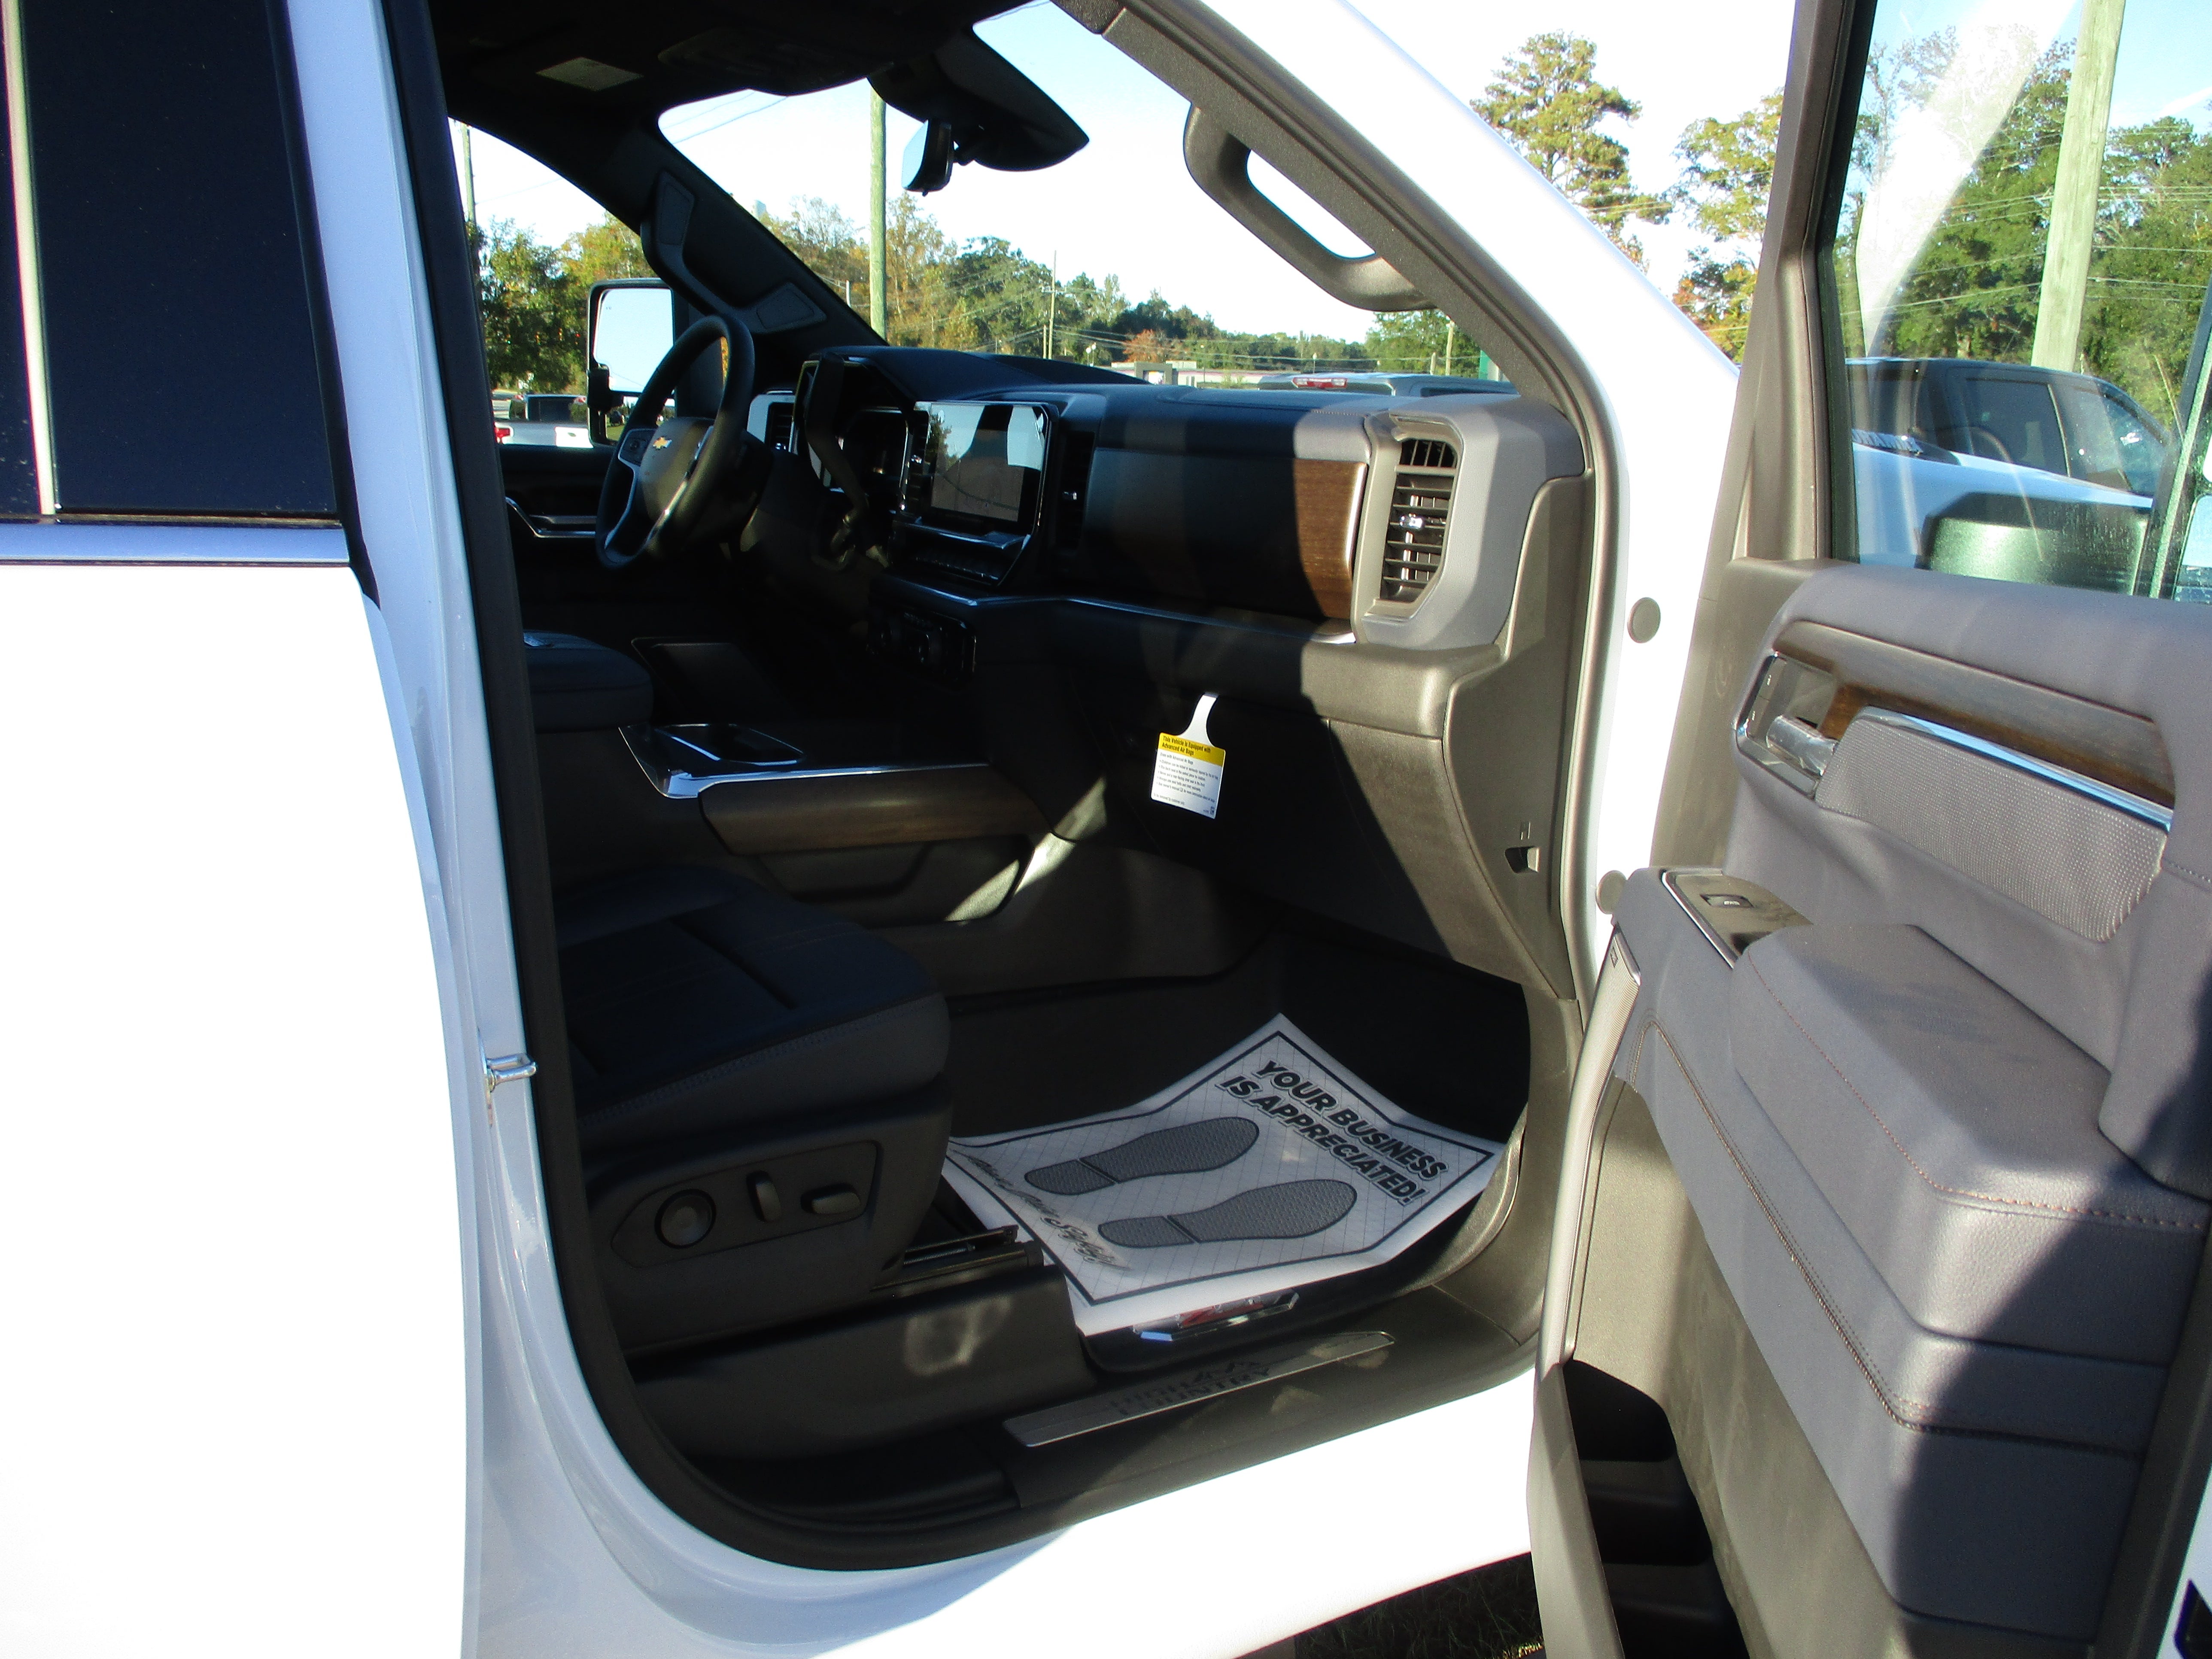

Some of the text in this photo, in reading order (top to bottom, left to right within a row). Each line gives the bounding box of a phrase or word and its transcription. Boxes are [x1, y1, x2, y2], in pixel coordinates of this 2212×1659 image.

[1162, 742, 1179, 751] Advanced
[1185, 748, 1194, 756] Bags
[1188, 742, 1203, 751] Equipped
[1216, 1076, 1429, 1206] IS APPRECIATED!
[1254, 1060, 1448, 1181] YOUR BUSINESS
